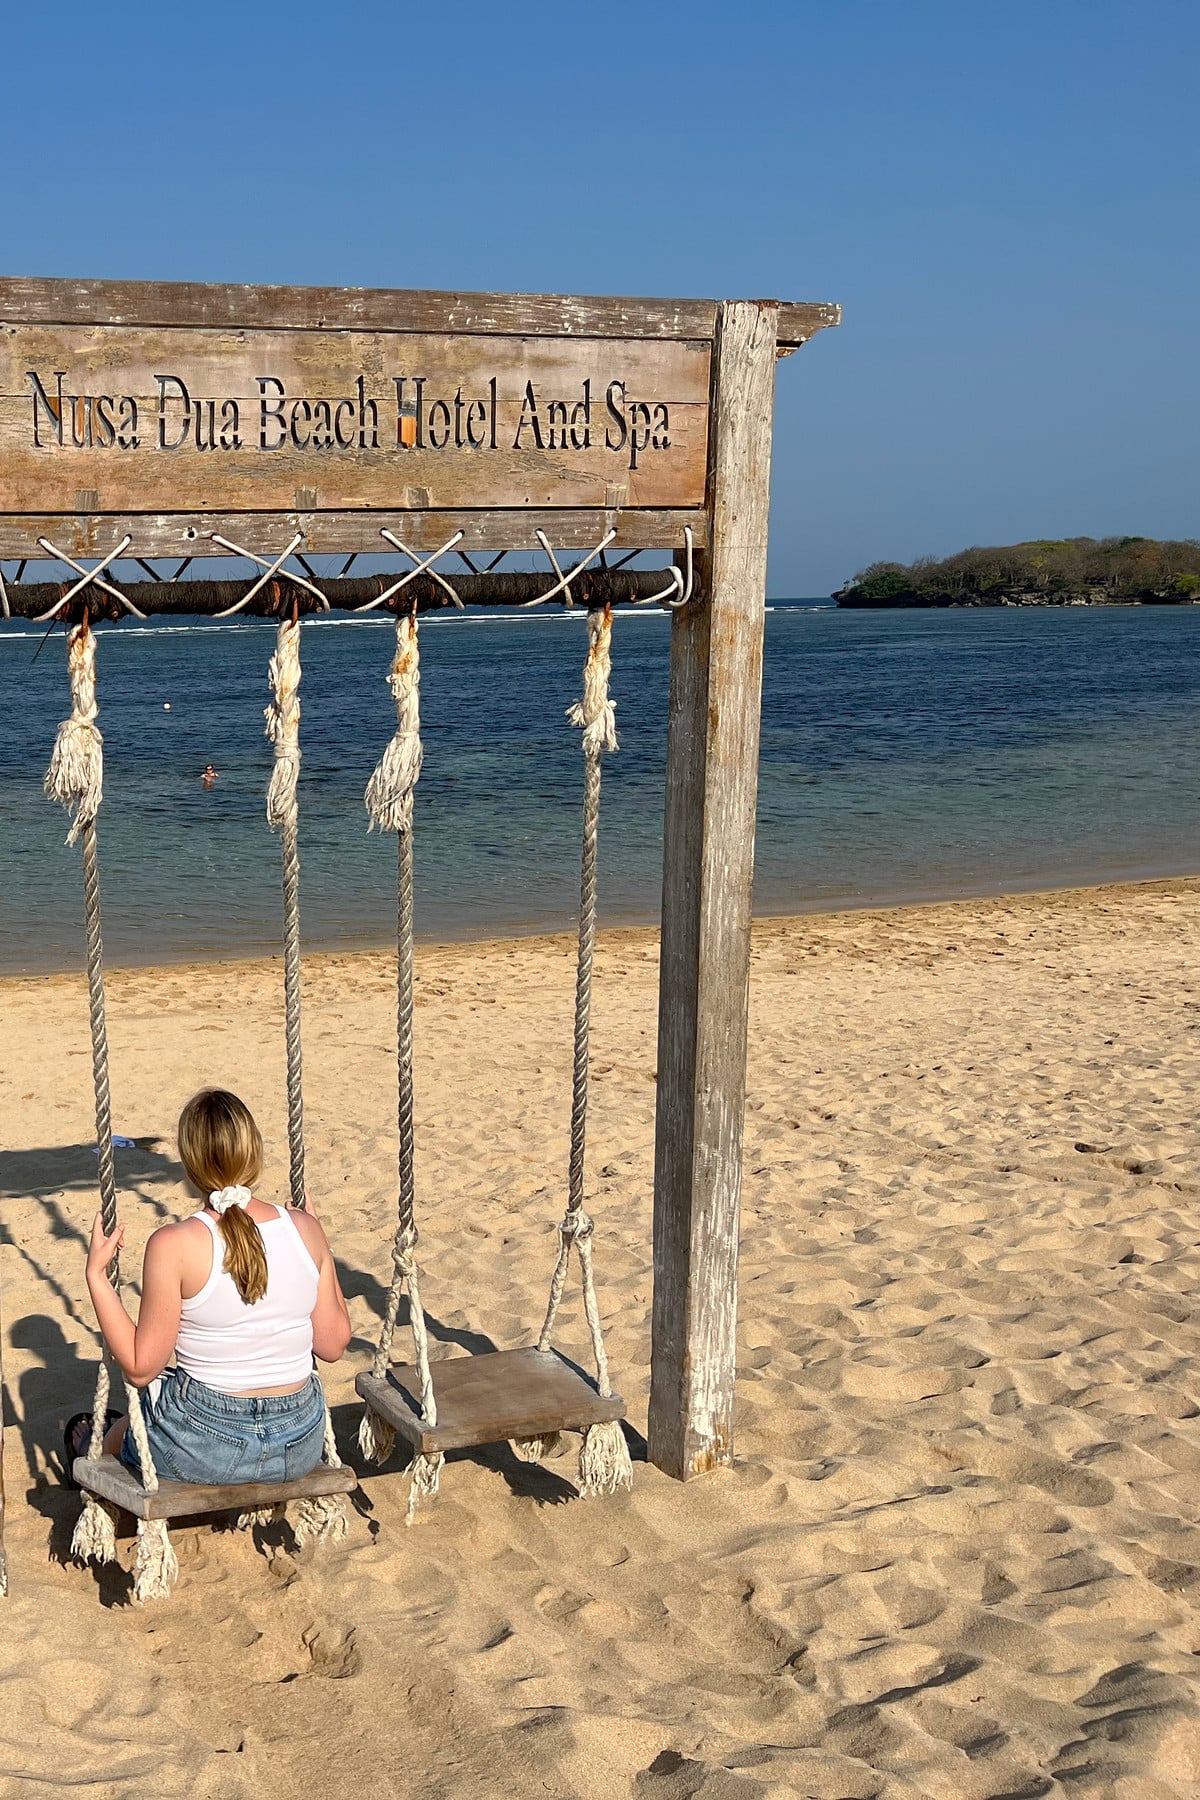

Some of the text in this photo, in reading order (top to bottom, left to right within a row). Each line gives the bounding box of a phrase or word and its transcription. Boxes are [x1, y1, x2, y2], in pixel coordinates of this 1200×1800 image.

[26, 371, 671, 470] Nusa Dua Beach Hotel And Spa
